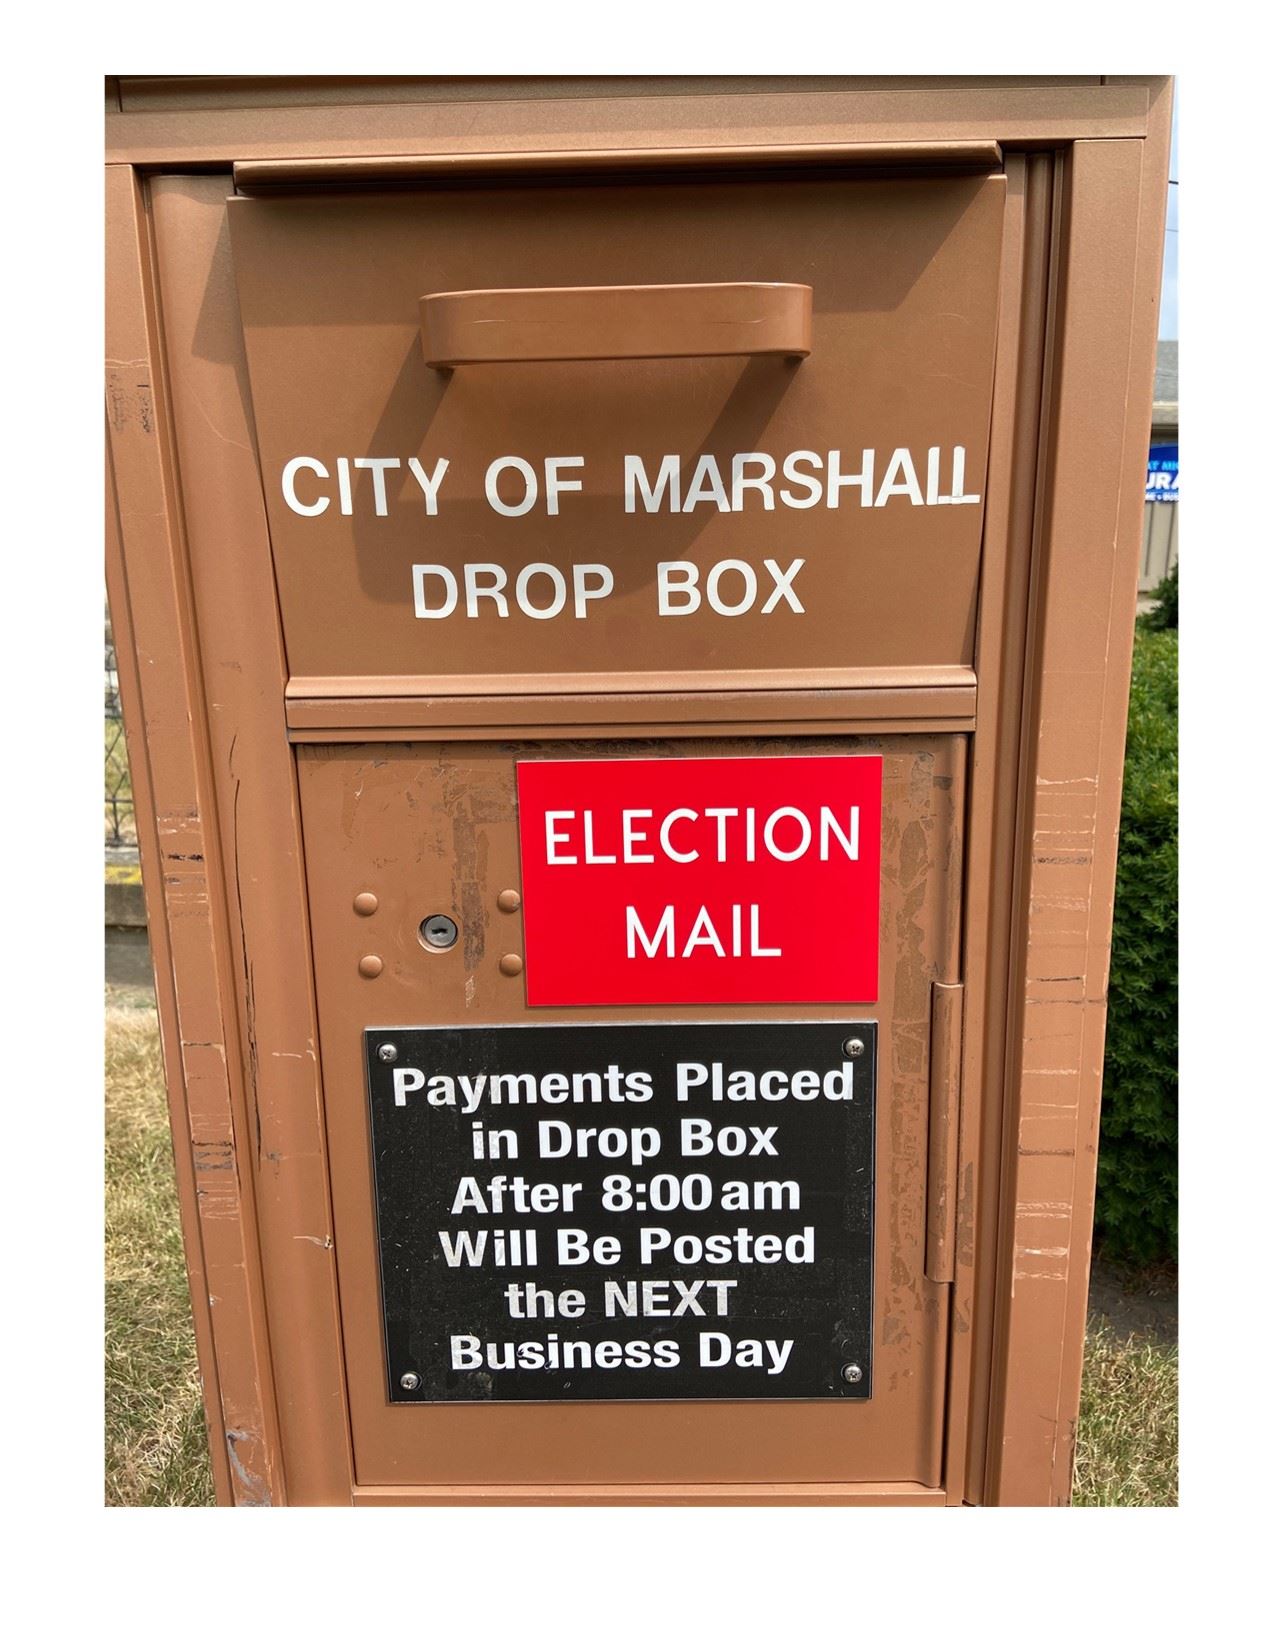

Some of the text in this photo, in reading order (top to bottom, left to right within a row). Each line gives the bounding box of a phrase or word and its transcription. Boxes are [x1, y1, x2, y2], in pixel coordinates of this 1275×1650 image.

[281, 445, 981, 517] CITY OF MARSHALL
[412, 558, 806, 620] DROP BOX
[544, 805, 860, 865] ELECTION
[626, 904, 782, 959] MAIL
[392, 1061, 854, 1114] Payments Placed
[471, 1118, 779, 1166] in Drop Box
[450, 1173, 800, 1215] After 8:00 am
[438, 1226, 815, 1268] Will Be Posted
[503, 1279, 738, 1319] the NEXT
[450, 1332, 795, 1375] Business Day
